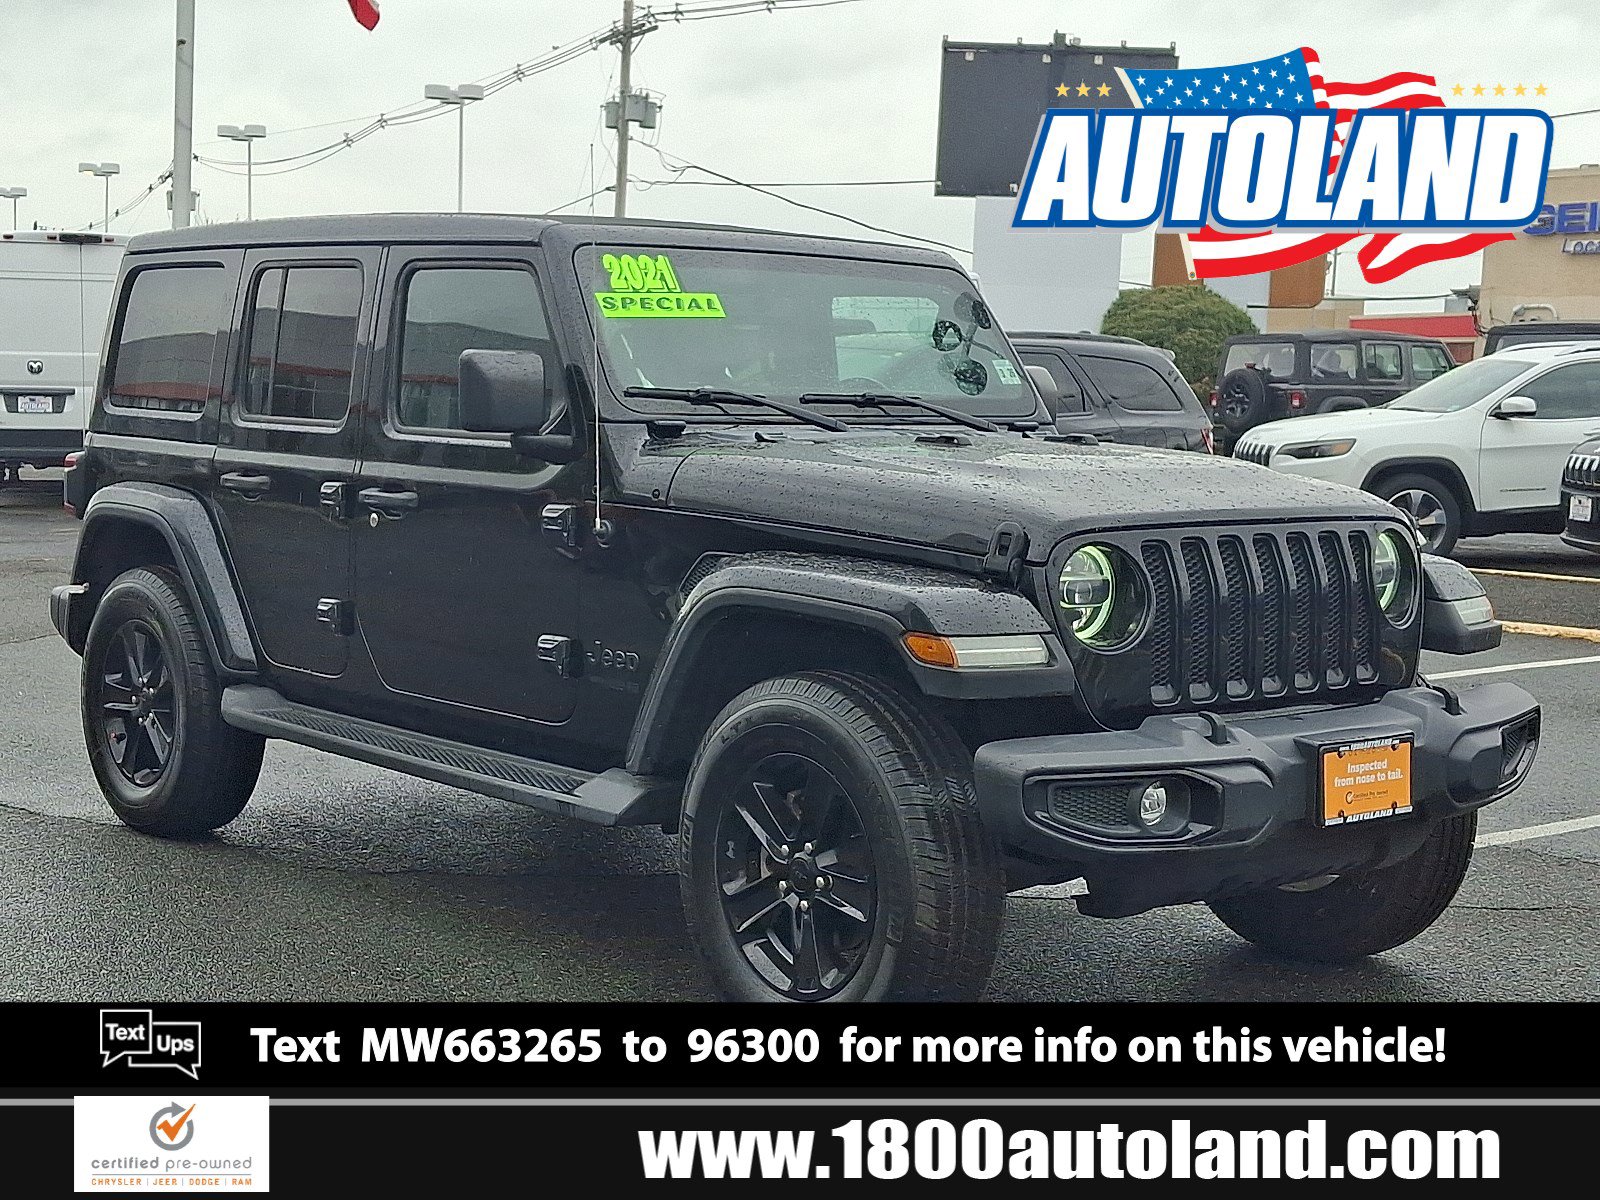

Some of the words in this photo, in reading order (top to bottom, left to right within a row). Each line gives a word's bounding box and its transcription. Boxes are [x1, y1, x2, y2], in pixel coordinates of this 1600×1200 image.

[602, 253, 682, 292] 2021
[602, 296, 721, 311] SPECIAL
[586, 640, 640, 672] Jeep
[1347, 758, 1388, 774] Inspected
[1334, 776, 1354, 787] from
[1355, 773, 1376, 785] nose
[1377, 770, 1386, 782] to
[1387, 767, 1404, 780] tail.
[1346, 808, 1394, 823] AUTOLAND
